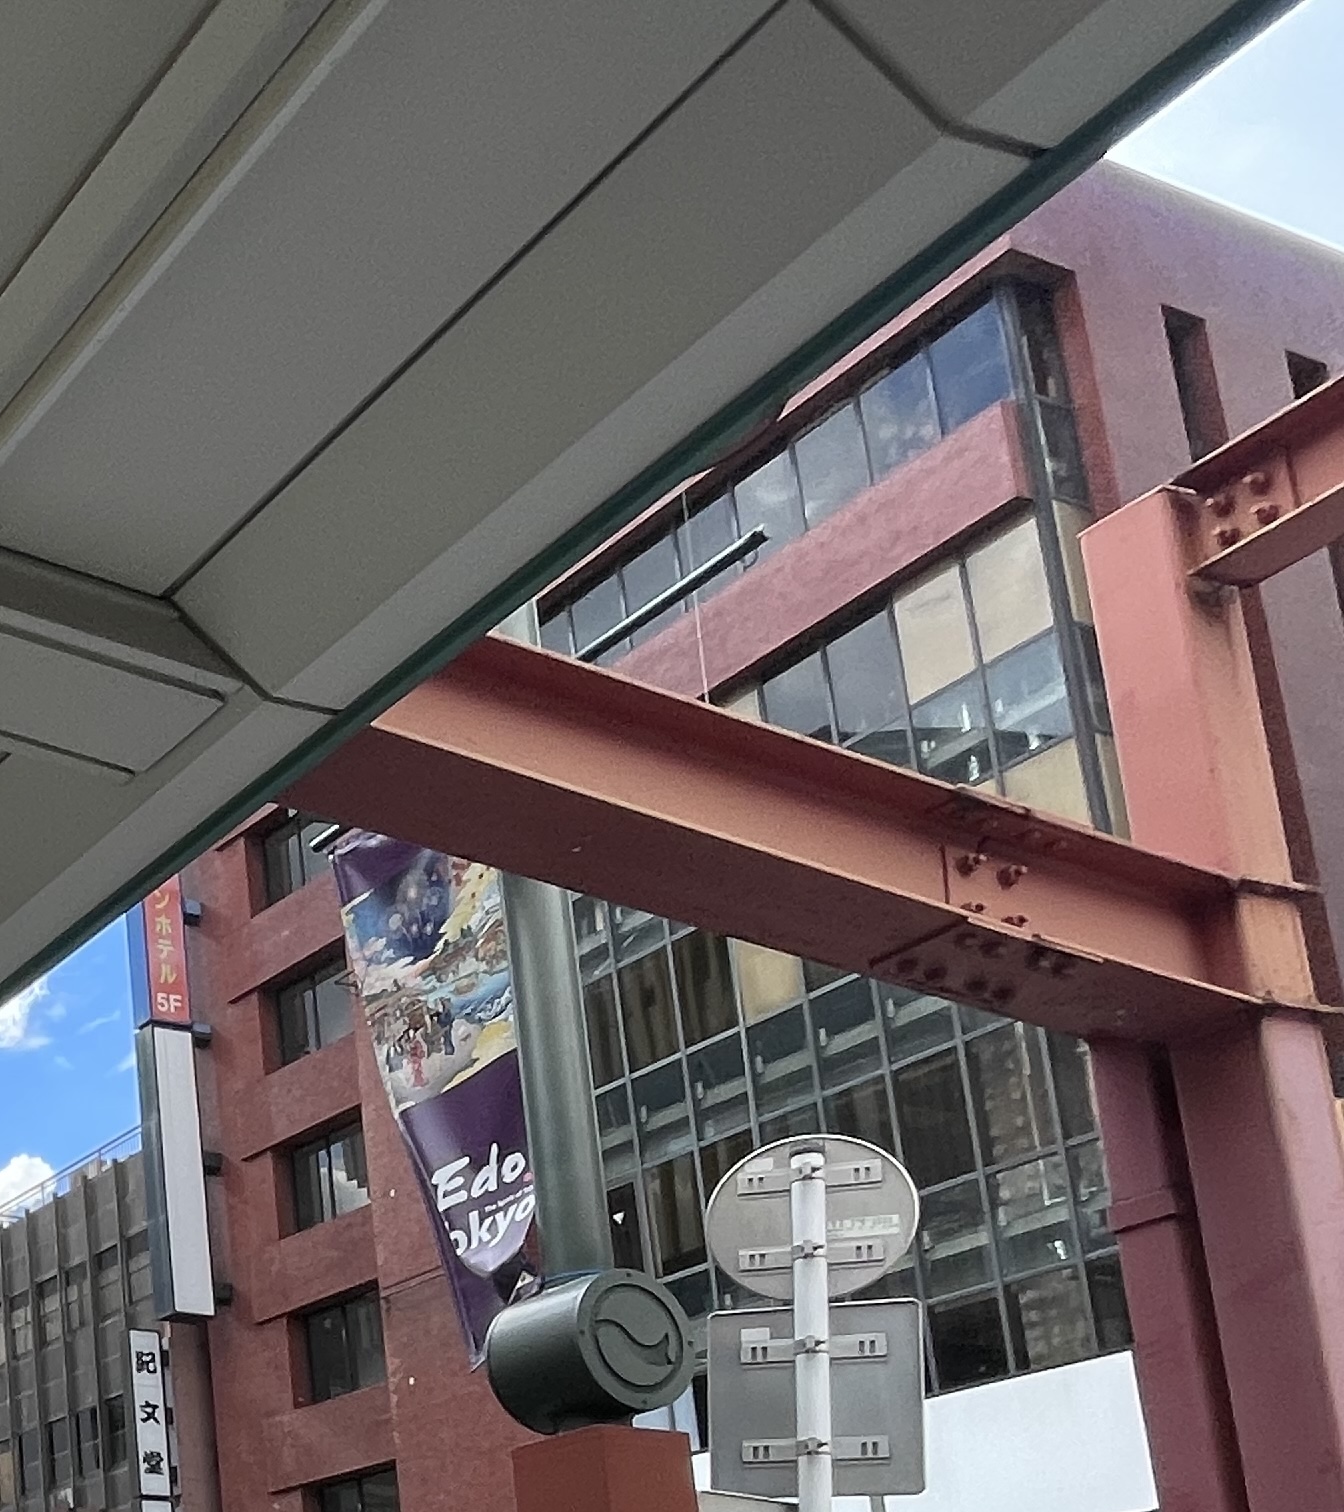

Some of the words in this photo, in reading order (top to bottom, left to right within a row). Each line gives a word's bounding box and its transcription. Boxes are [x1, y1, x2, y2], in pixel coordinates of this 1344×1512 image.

[156, 992, 182, 1013] 5F
[431, 1142, 526, 1213] Edo
[445, 1194, 535, 1256] okyo
